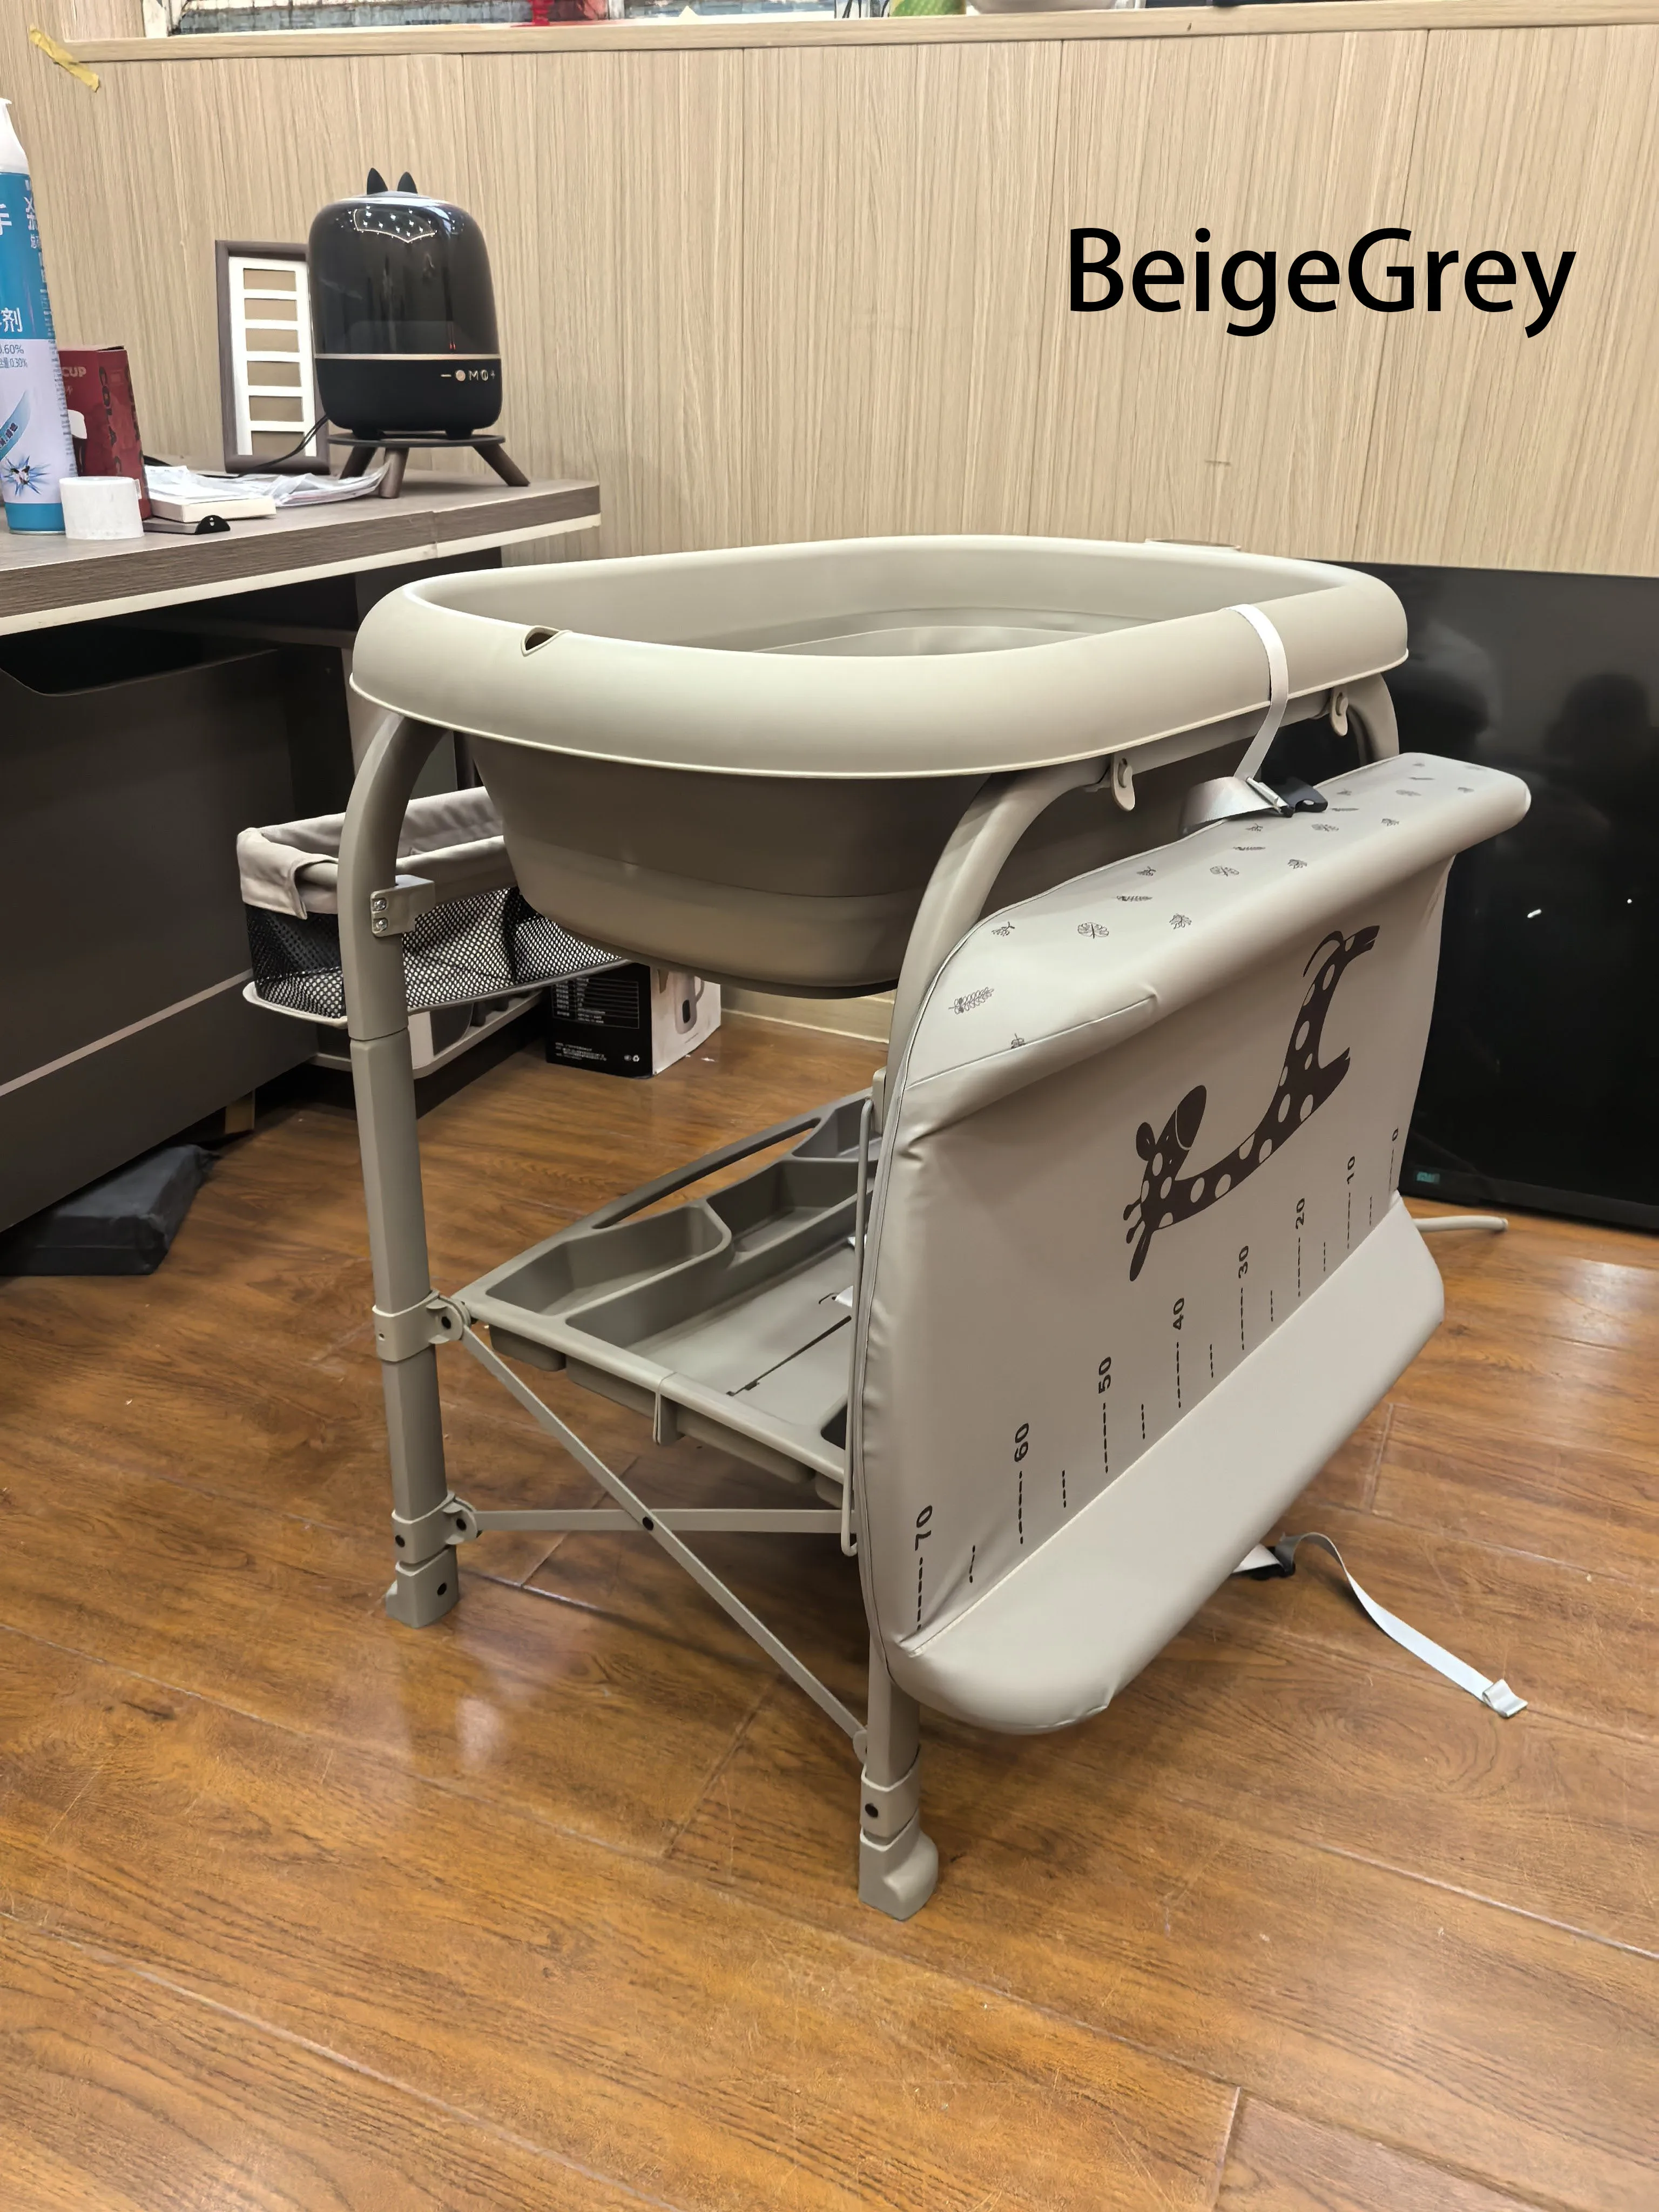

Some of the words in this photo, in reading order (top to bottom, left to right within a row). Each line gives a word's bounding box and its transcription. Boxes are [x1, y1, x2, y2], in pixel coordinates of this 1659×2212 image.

[0, 307, 23, 333] 剂
[1346, 1155, 1355, 1185] 10
[1294, 1197, 1305, 1230] 20
[1238, 1245, 1250, 1279] 30
[1172, 1297, 1185, 1331] 40
[1098, 1356, 1112, 1394] 50
[1014, 1422, 1030, 1463] 60
[914, 1505, 933, 1552] 70
